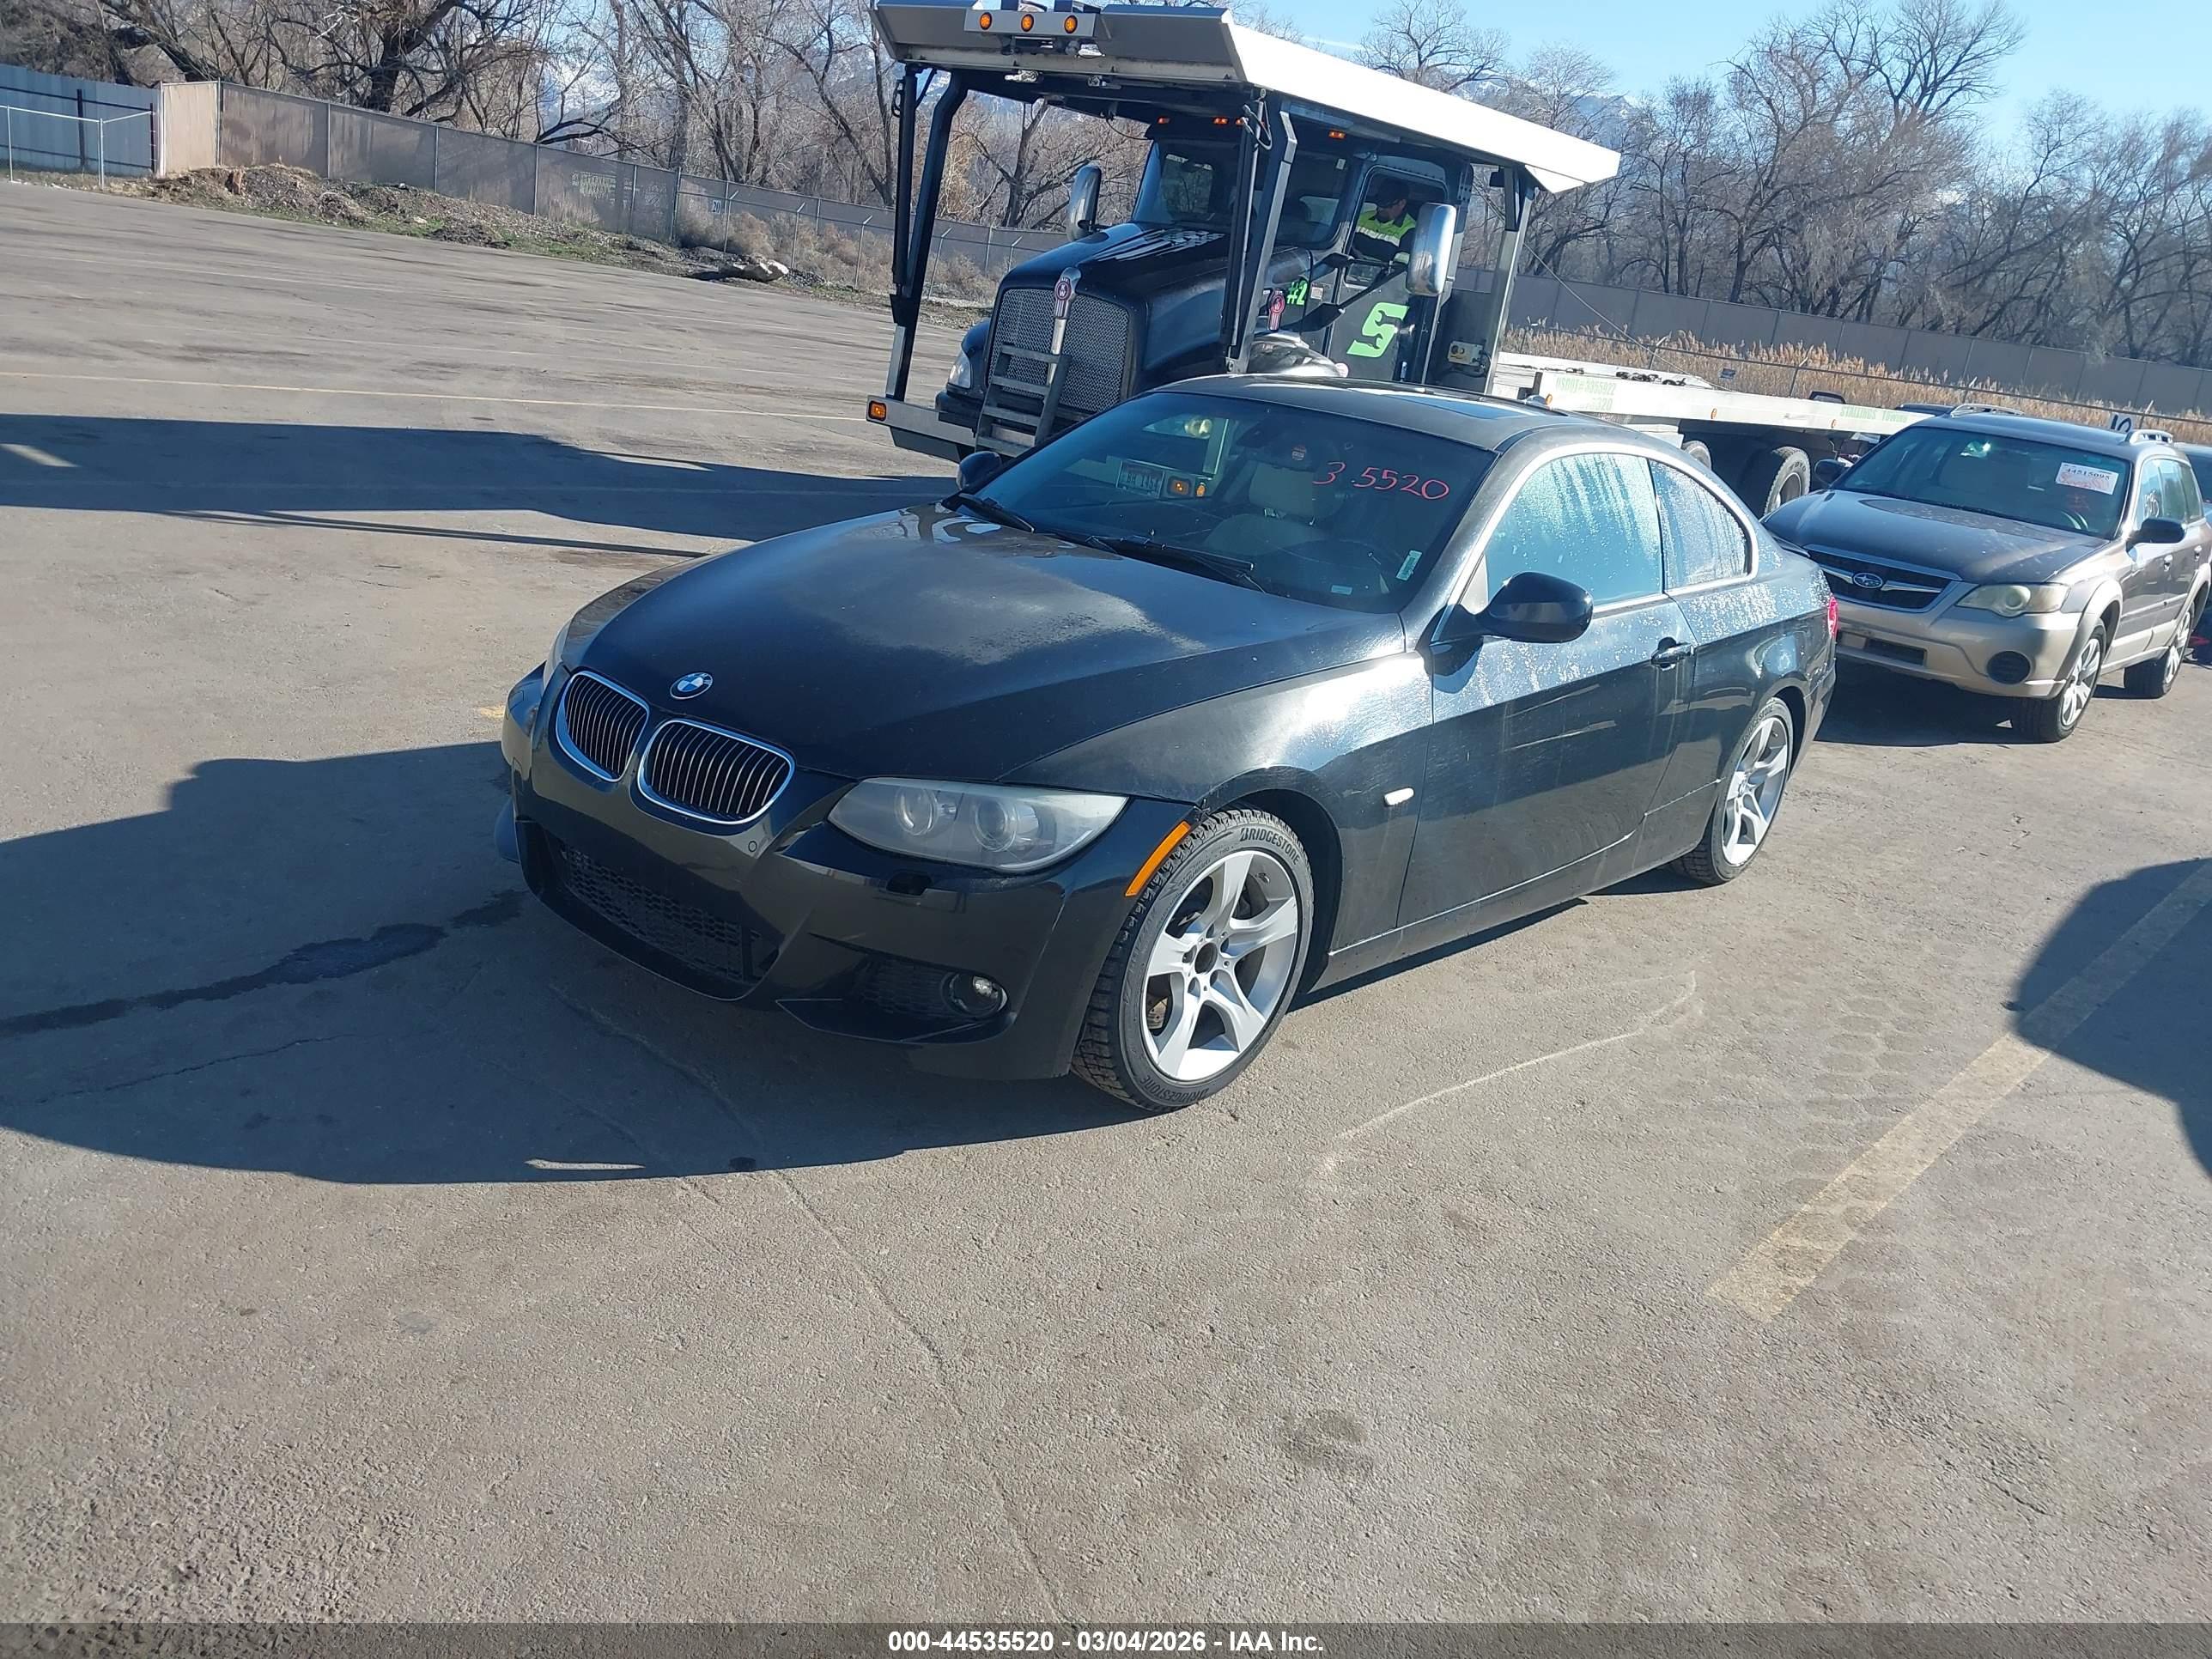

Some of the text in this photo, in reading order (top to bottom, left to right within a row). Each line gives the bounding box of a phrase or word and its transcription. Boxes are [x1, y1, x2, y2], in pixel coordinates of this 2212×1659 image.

[713, 200, 721, 214] 20
[1287, 280, 1308, 306] #2
[1346, 302, 1409, 358] S
[1312, 461, 1449, 500] 3 5520
[1239, 827, 1301, 866] BRIDGESTONE
